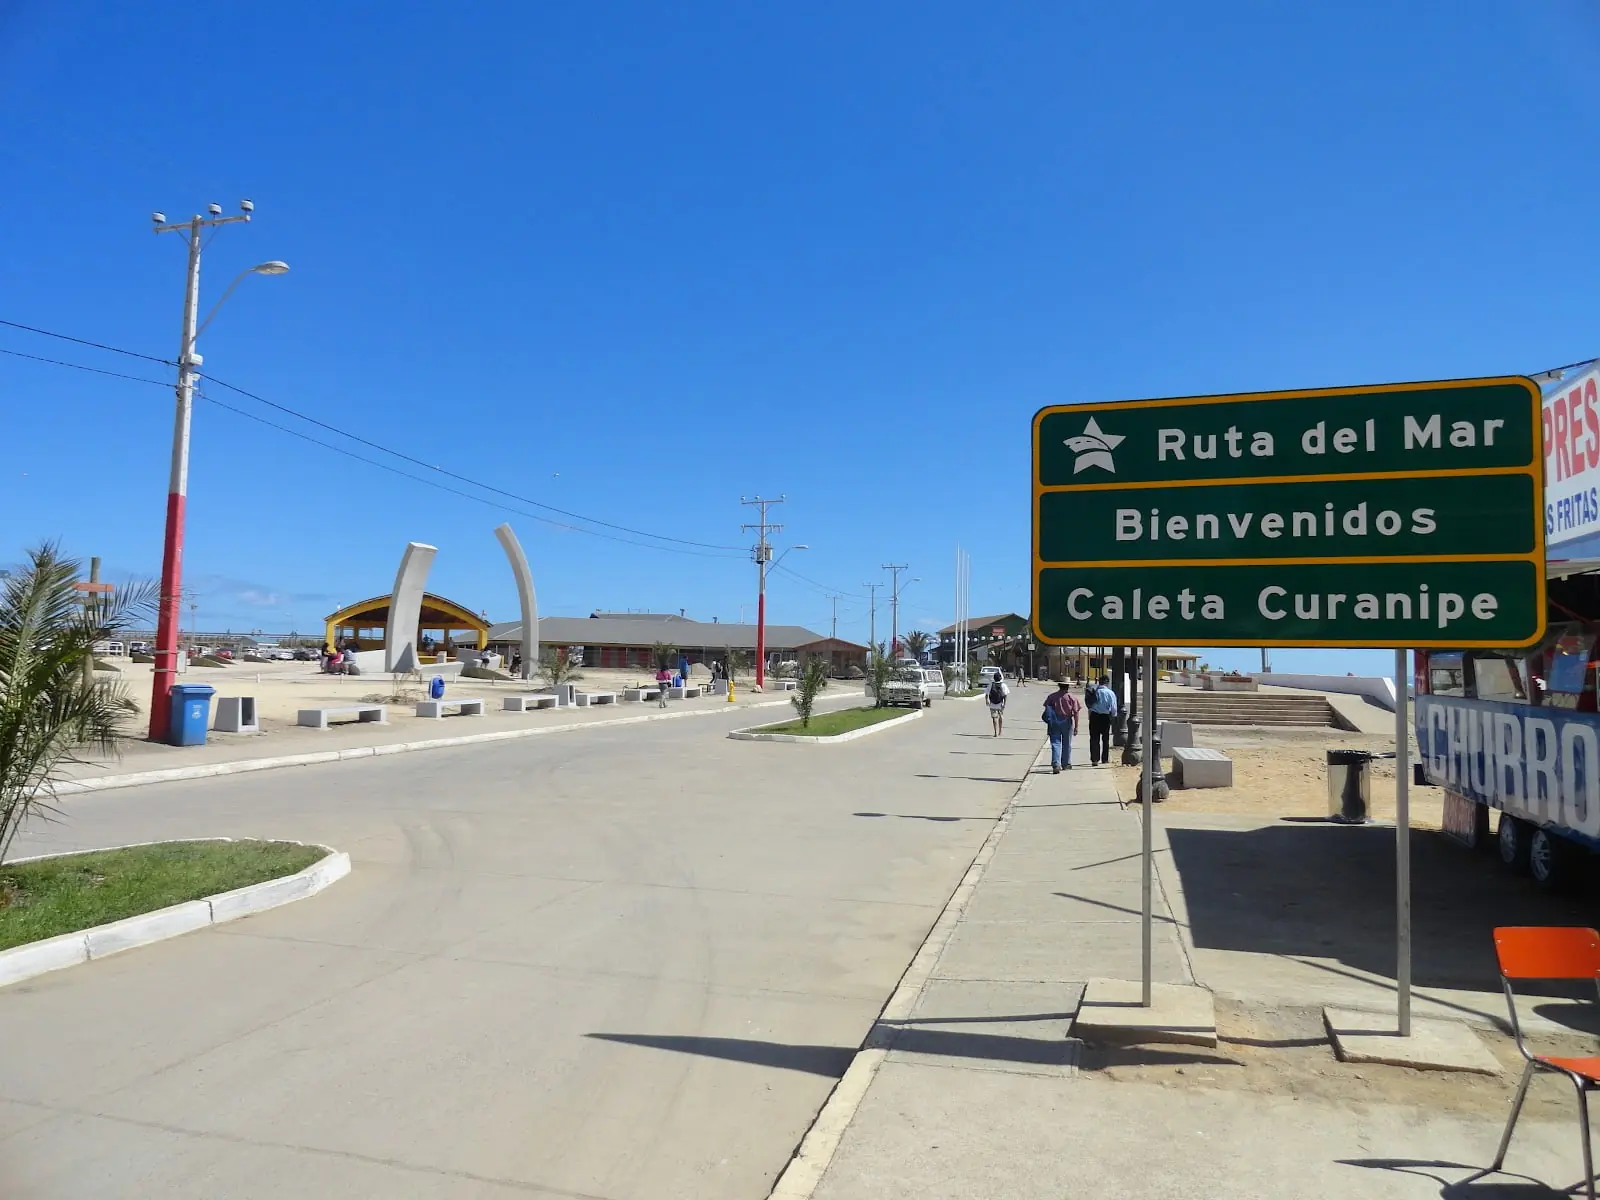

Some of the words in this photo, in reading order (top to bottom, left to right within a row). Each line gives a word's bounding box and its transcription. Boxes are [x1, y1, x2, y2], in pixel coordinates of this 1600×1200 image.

[1157, 420, 1275, 462] Ruta
[1302, 418, 1376, 455] del
[1404, 415, 1505, 450] Mar
[1115, 502, 1437, 541] Bienvenidos
[1557, 488, 1599, 532] FRITAS
[1067, 588, 1226, 621] Caleta
[1258, 583, 1498, 629] Curanipe
[1428, 703, 1600, 838] CHURRO
